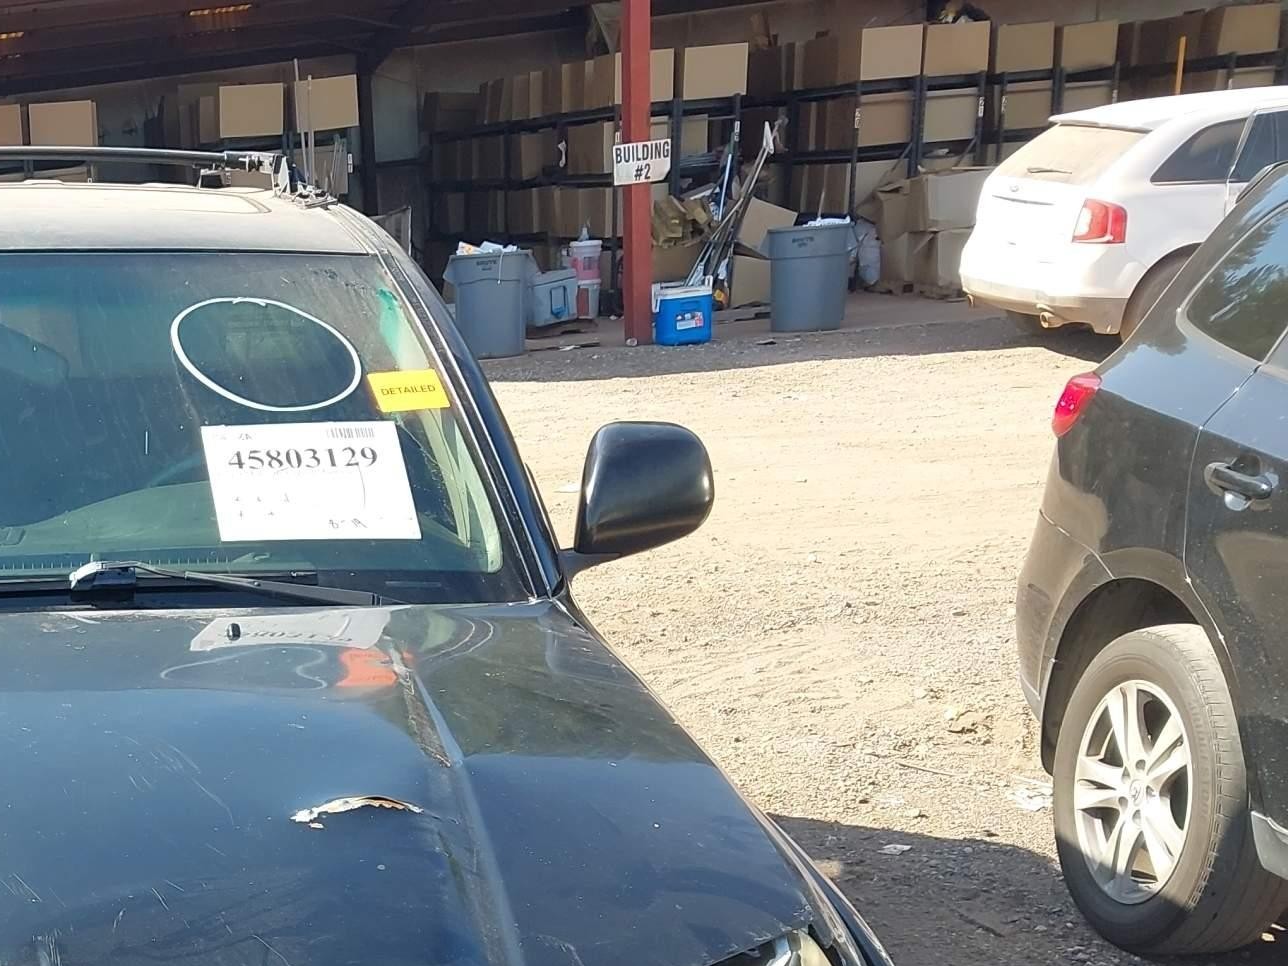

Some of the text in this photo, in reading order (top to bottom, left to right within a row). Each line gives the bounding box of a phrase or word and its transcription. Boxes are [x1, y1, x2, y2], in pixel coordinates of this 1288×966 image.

[615, 141, 670, 164] BUILDING
[634, 163, 651, 181] #2
[380, 384, 436, 396] DETAILED
[228, 446, 378, 470] 45803129
